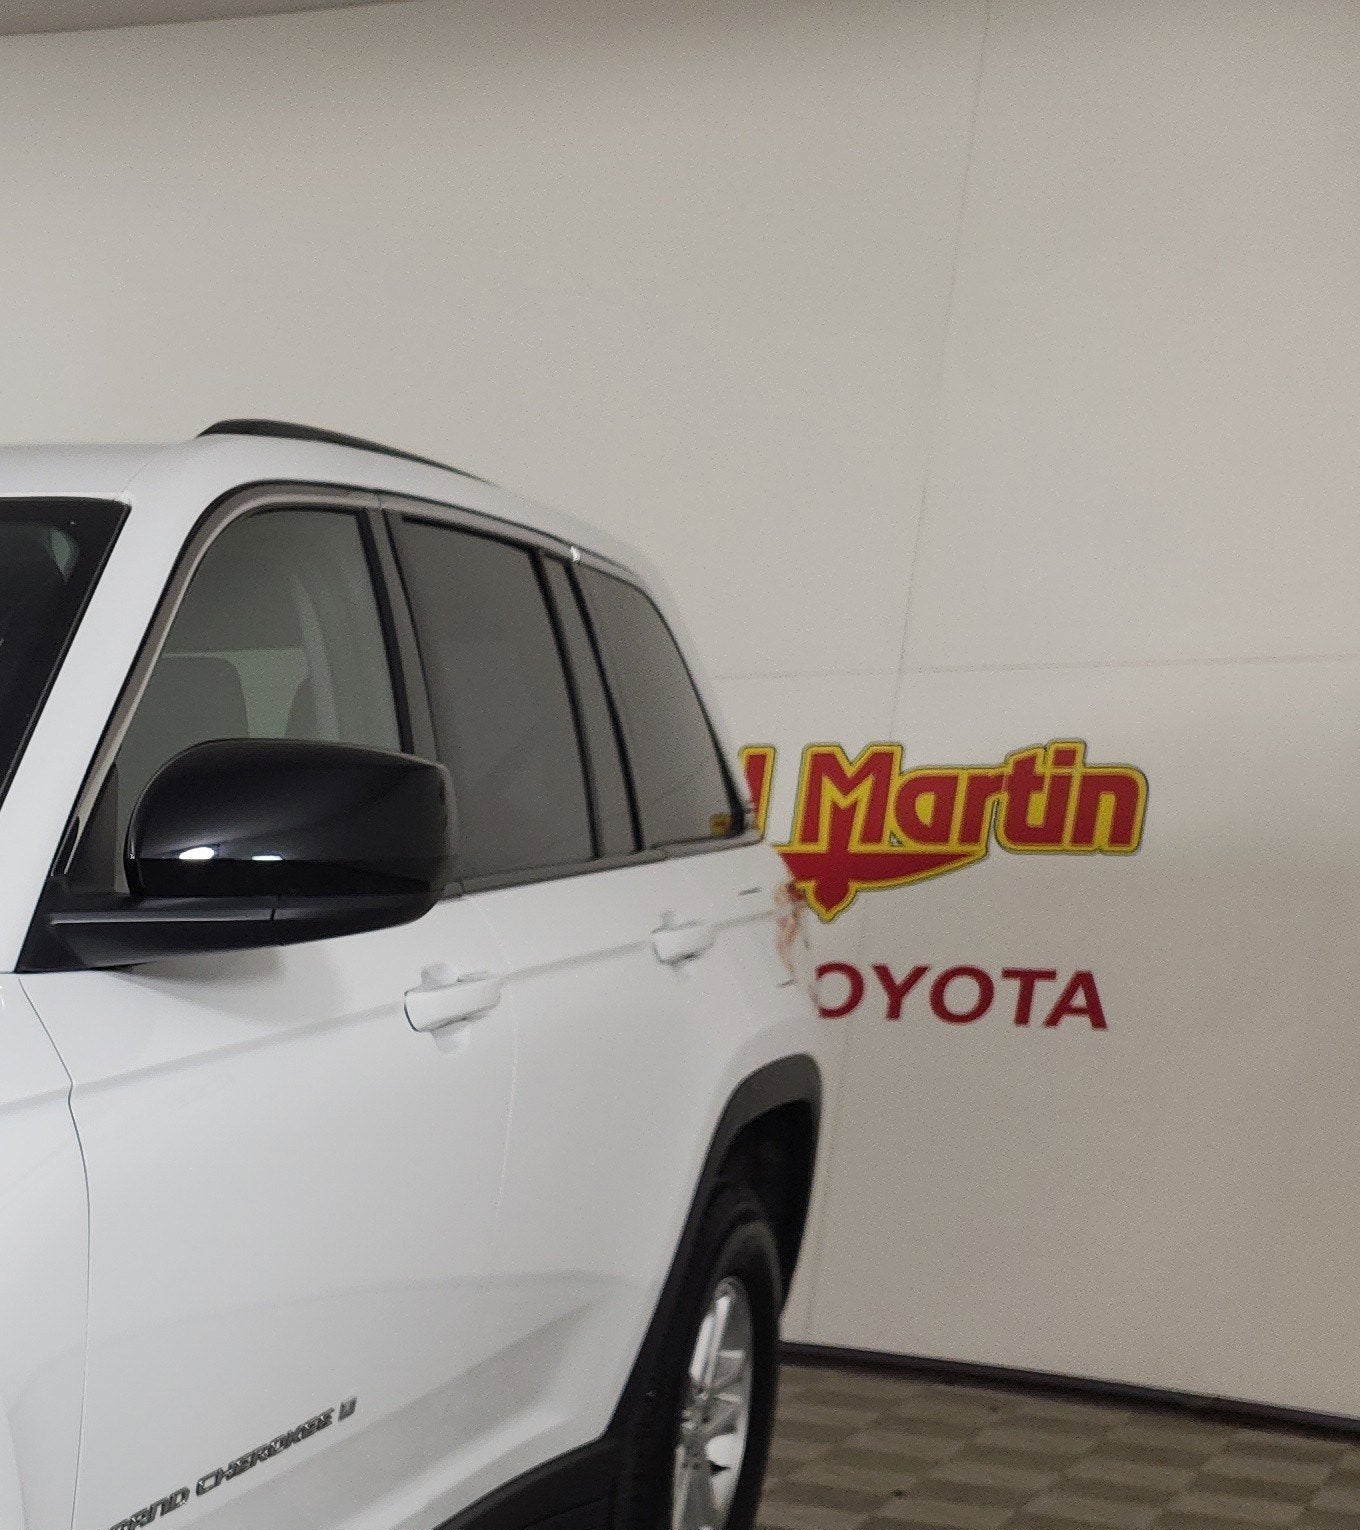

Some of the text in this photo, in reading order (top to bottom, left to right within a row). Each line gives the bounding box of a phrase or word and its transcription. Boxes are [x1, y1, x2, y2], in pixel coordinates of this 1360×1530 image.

[794, 743, 1144, 850] Martin
[816, 961, 1109, 1031] OYOTA
[195, 1406, 335, 1498] CHEROKEE
